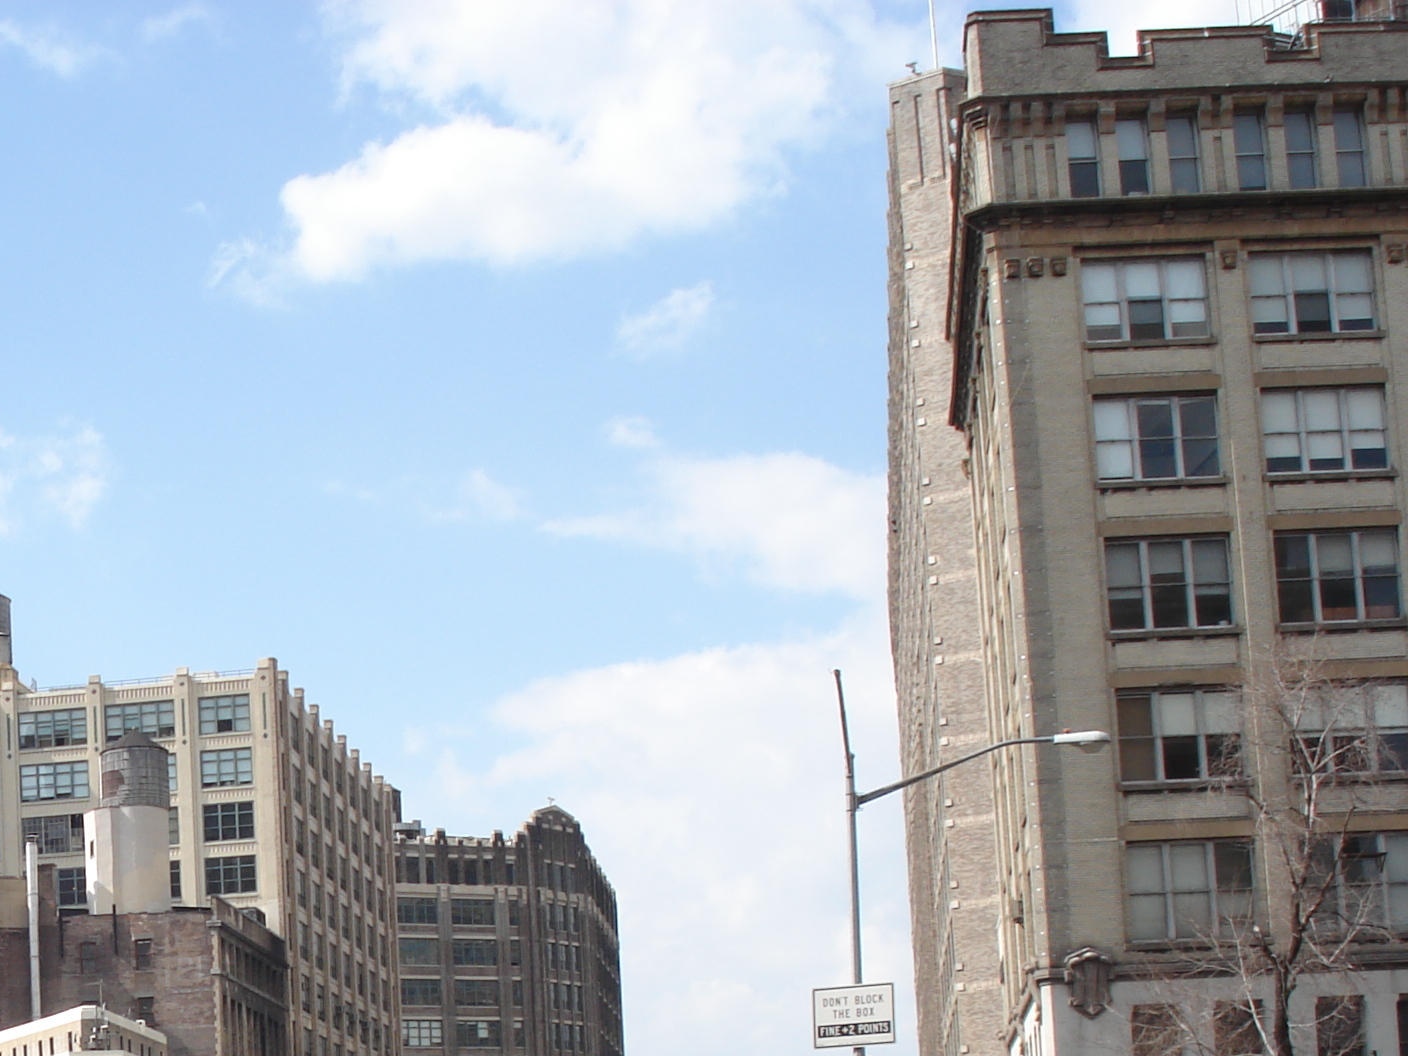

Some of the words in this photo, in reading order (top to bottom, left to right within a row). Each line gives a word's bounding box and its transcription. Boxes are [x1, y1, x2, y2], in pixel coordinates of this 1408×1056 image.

[822, 996, 848, 1008] DON'T
[854, 993, 884, 1006] BLOCK
[833, 1009, 851, 1019] THE
[856, 1007, 875, 1018] BOX
[857, 1022, 889, 1035] POINTS
